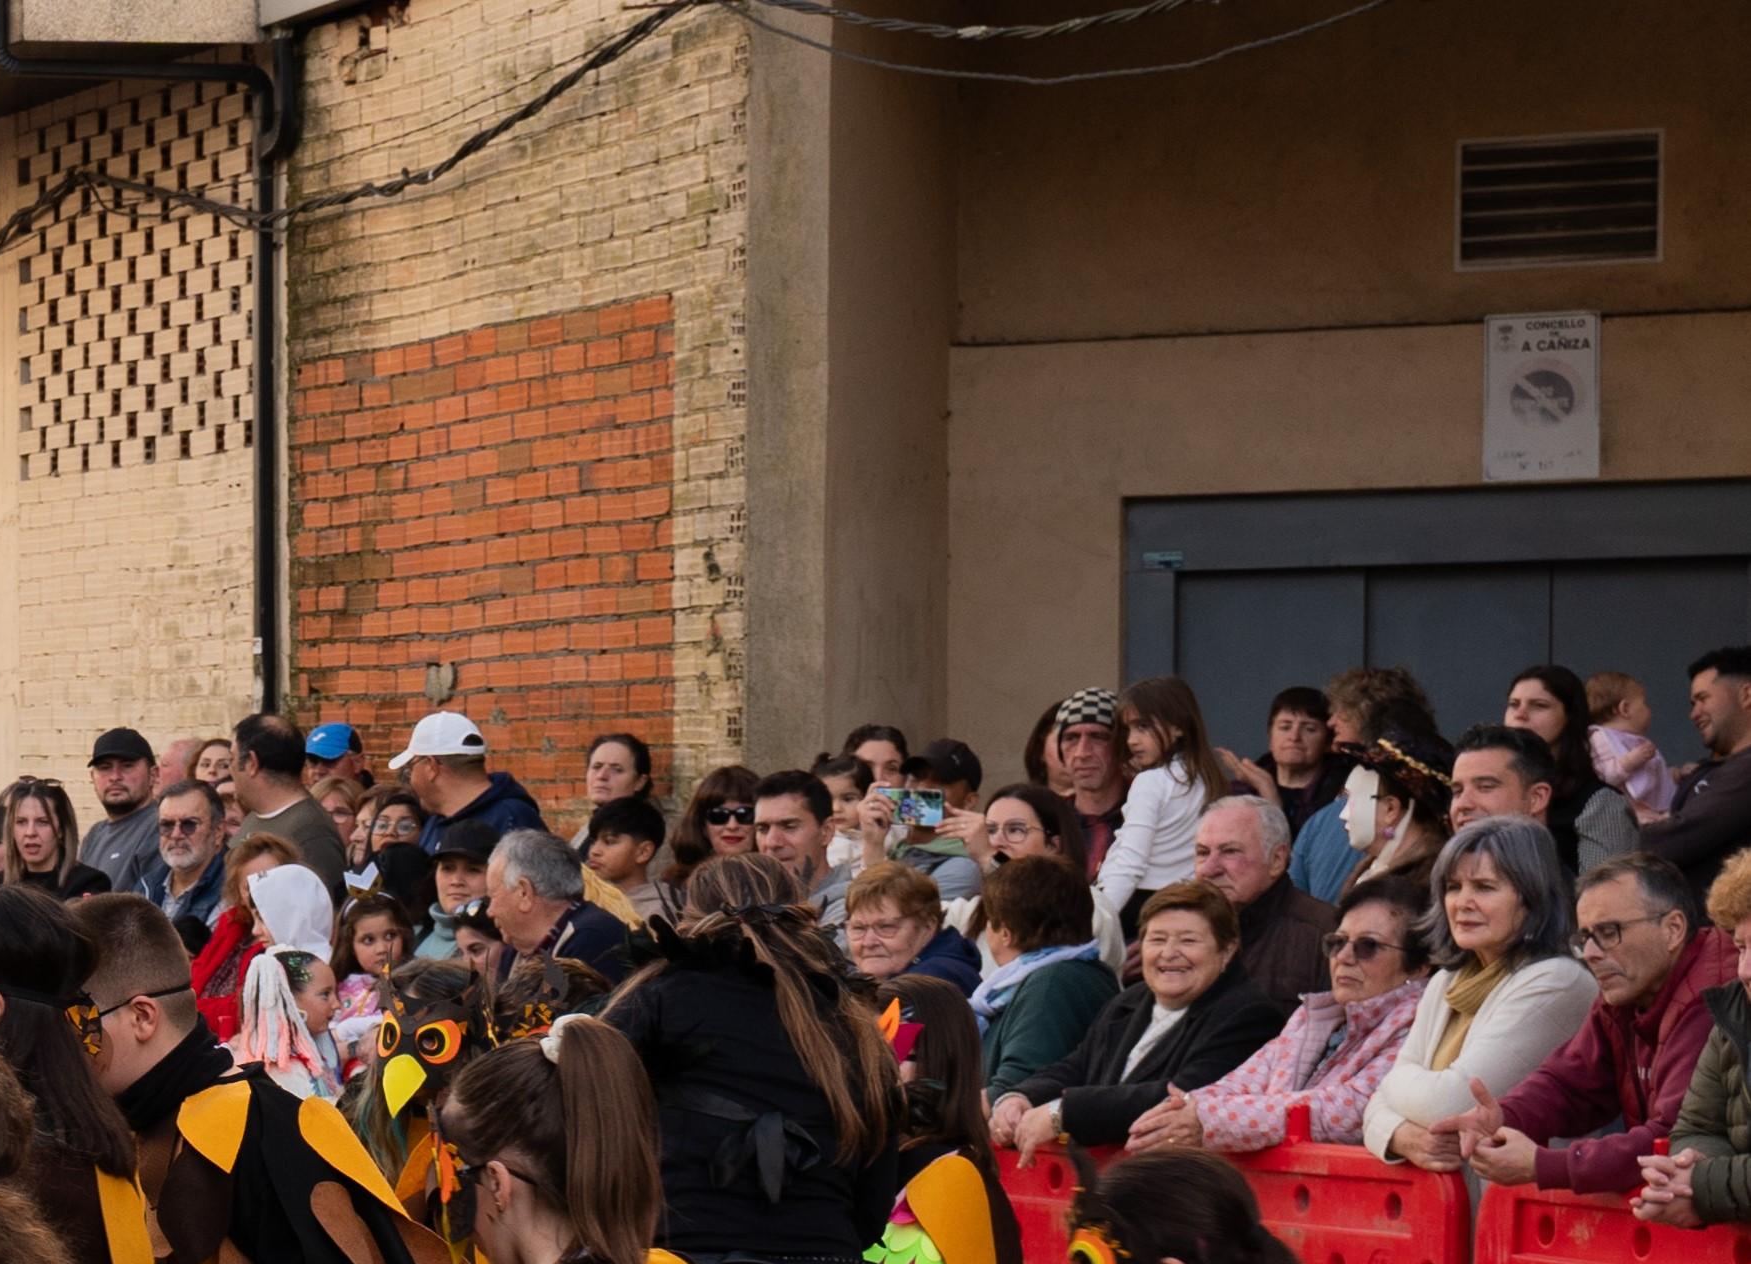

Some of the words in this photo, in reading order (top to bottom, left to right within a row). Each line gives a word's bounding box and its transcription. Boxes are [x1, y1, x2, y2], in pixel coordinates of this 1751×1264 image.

[1525, 319, 1586, 331] CONCELLO
[1521, 341, 1531, 352] A
[1537, 336, 1590, 352] CAÑIZA
